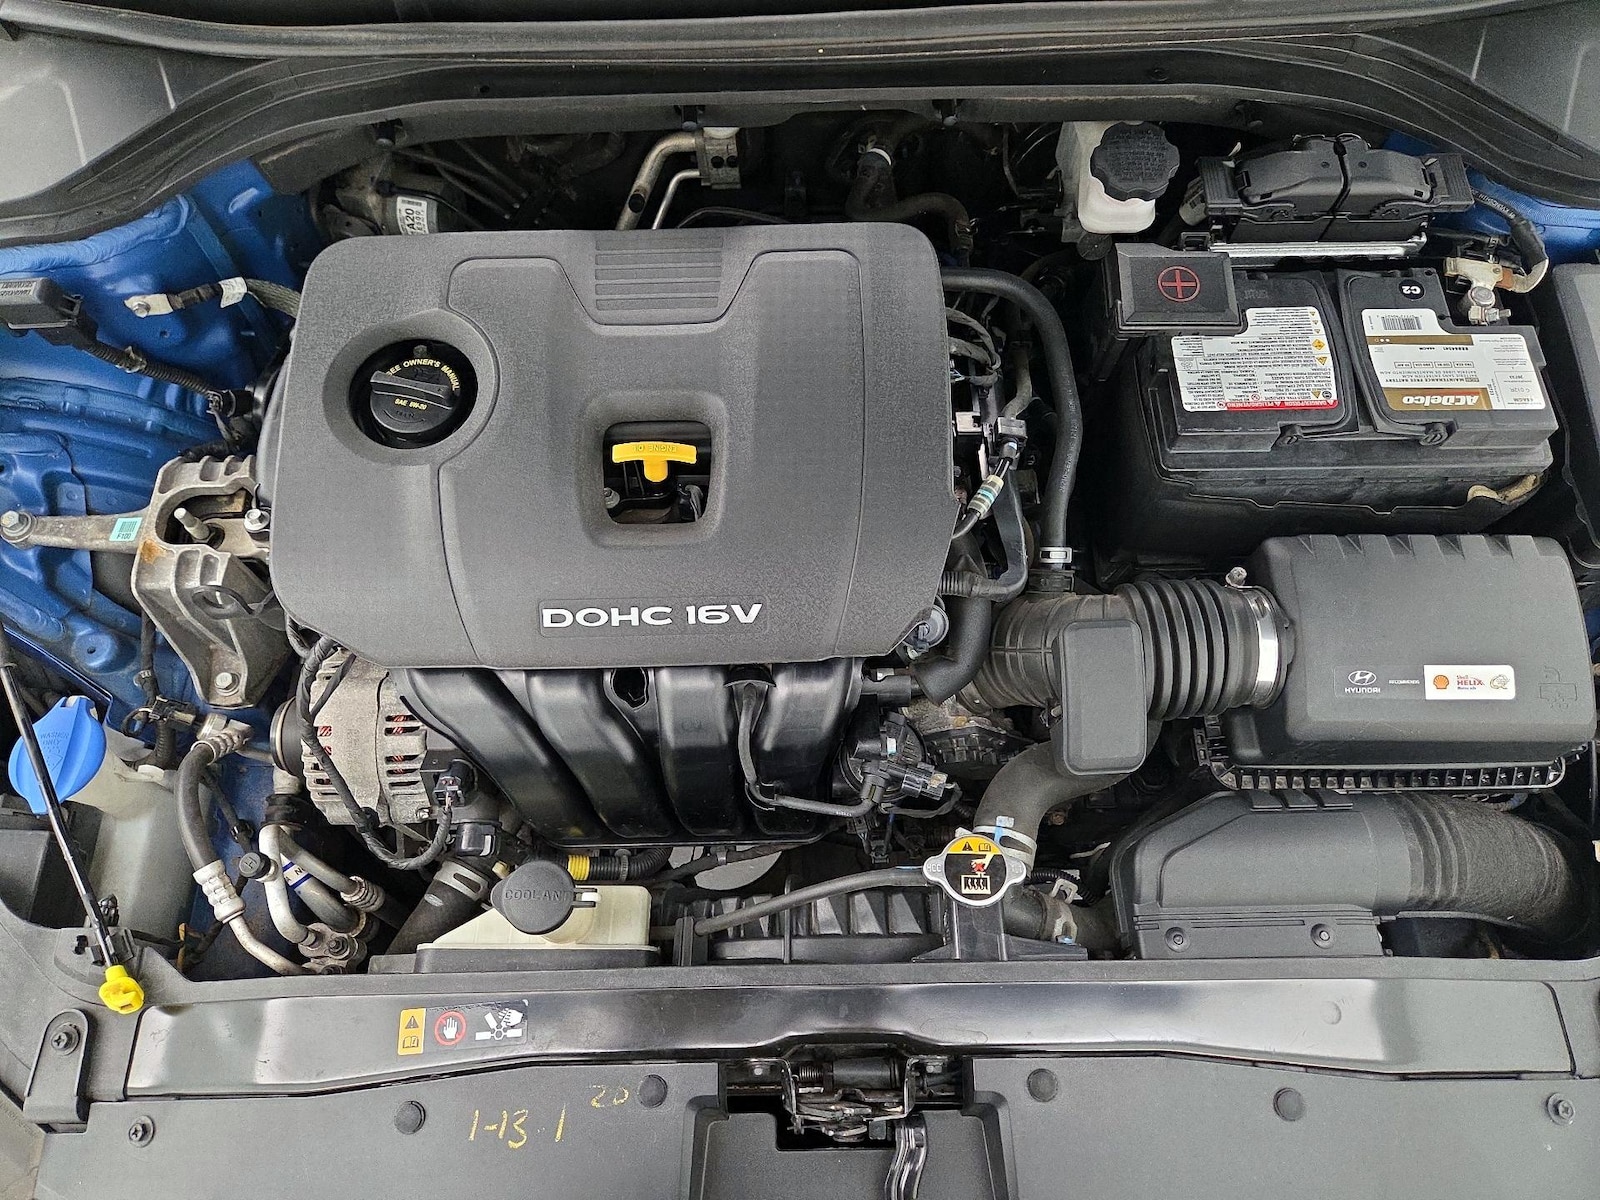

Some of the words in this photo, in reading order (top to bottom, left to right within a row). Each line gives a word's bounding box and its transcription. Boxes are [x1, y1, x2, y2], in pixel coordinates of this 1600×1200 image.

[1402, 285, 1421, 295] C2
[385, 364, 402, 377] SEE
[403, 358, 441, 368] OWNER'S
[441, 365, 461, 392] MANUAL
[394, 398, 408, 407] SAE
[1402, 395, 1479, 406] ACDelco
[648, 444, 677, 453] ENGINE
[542, 606, 673, 628] DOHC
[686, 603, 763, 625] 16V
[40, 731, 70, 740] WASHER
[505, 889, 573, 902] COOLANT
